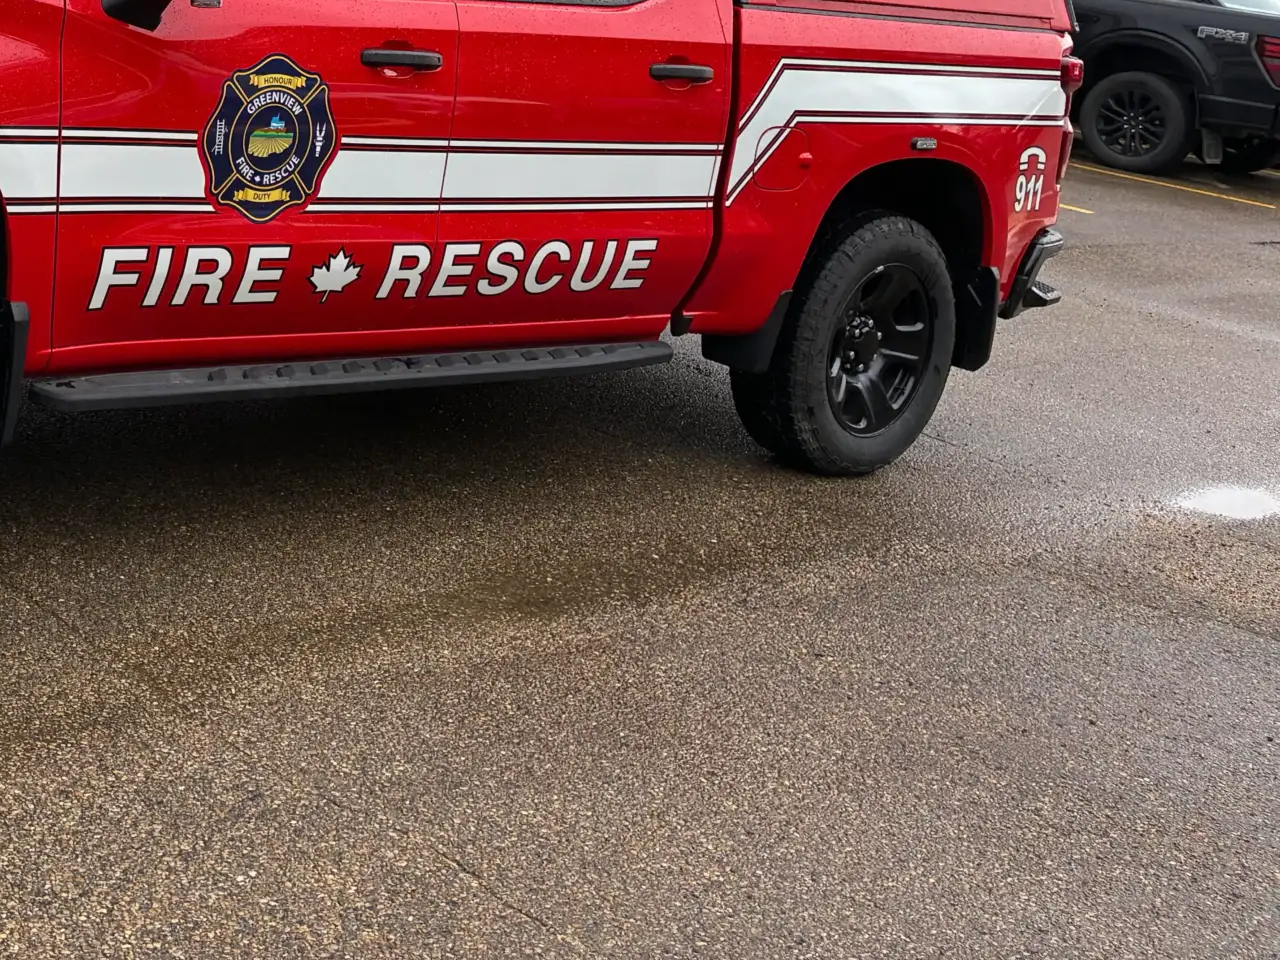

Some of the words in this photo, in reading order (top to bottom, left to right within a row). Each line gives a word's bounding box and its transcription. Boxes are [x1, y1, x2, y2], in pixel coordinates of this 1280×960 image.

[1197, 26, 1249, 42] FX4
[263, 77, 293, 86] HONOUR
[246, 91, 303, 116] GREENVIEW
[235, 156, 255, 181] FIRE
[262, 154, 300, 185] RESCUE
[252, 192, 272, 201] DUTY
[1014, 174, 1044, 212] 911
[86, 245, 290, 311] FIRE
[375, 238, 659, 300] RESCUE
